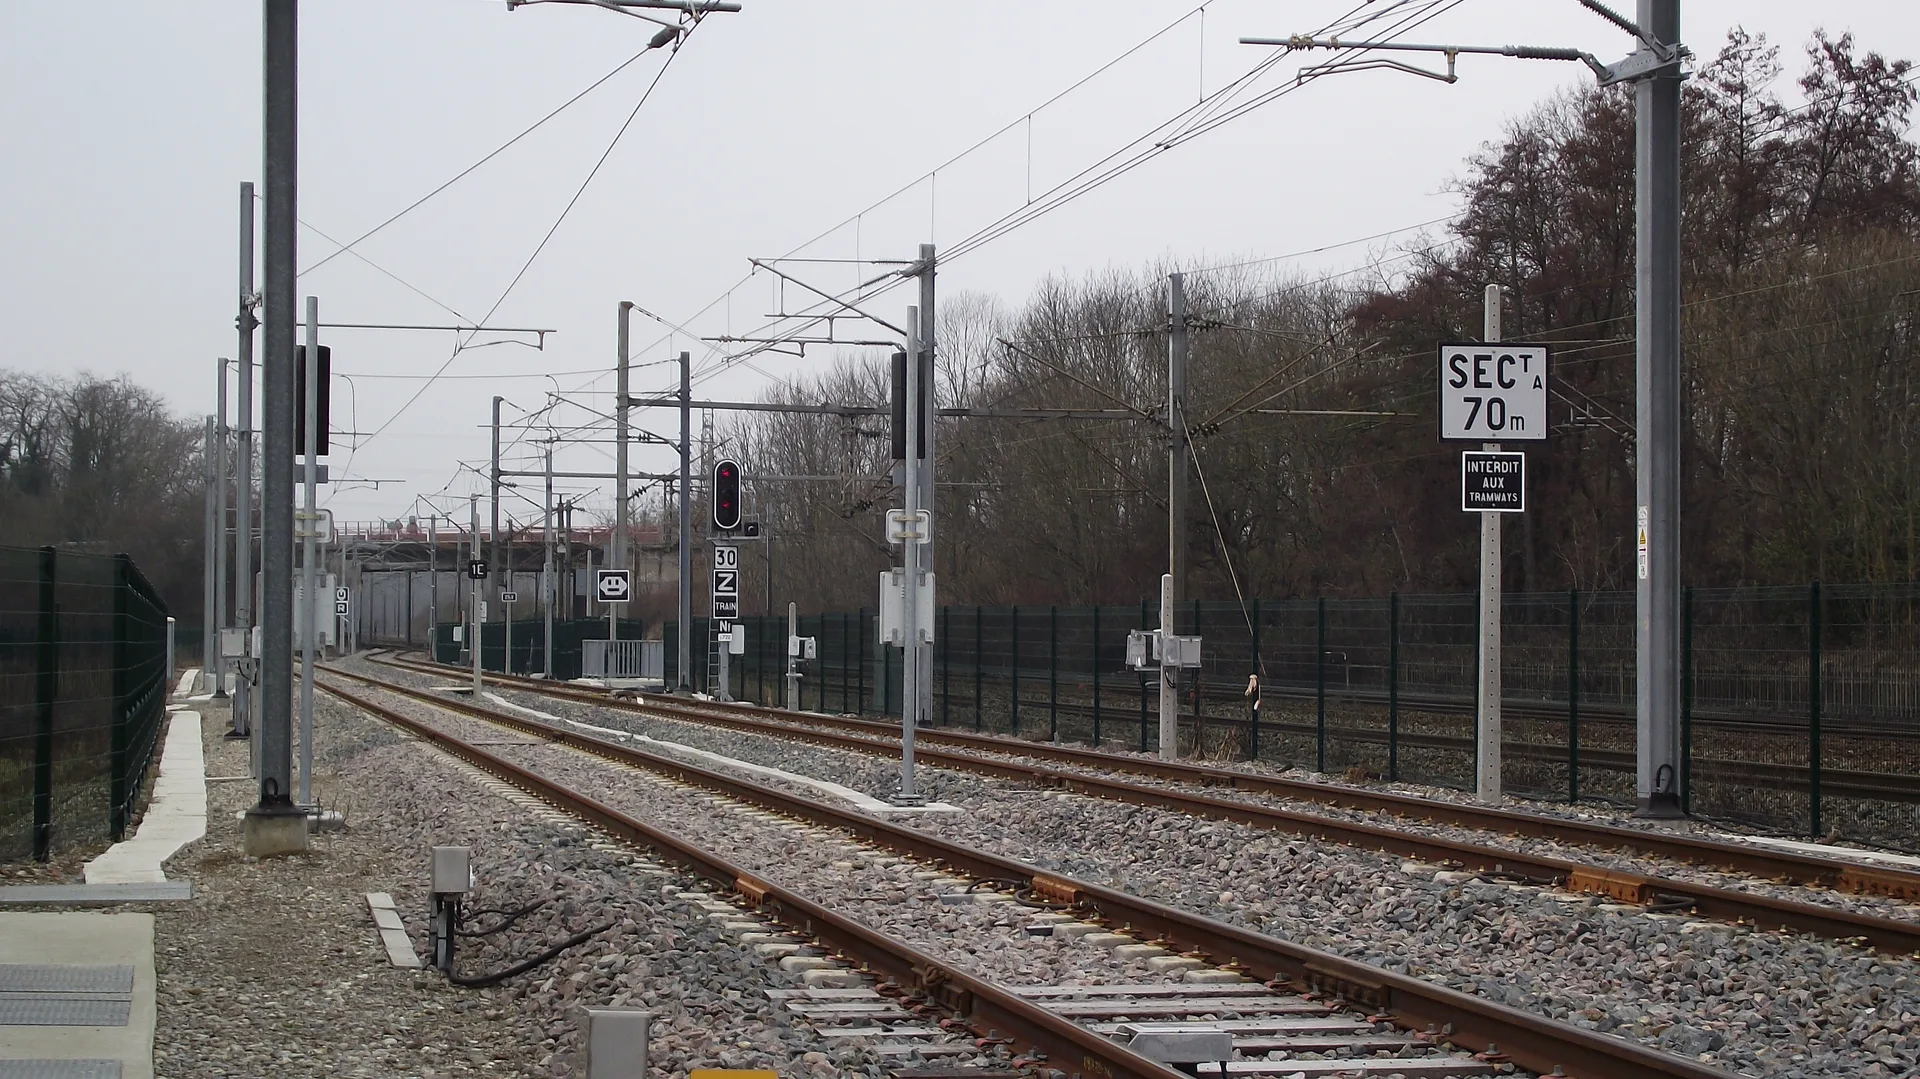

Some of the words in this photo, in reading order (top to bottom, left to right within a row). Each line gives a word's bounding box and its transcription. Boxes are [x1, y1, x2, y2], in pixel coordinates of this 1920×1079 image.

[1467, 461, 1519, 473] INTERDIT
[1482, 477, 1505, 489] AUX
[1469, 491, 1518, 503] TRAMWAYS
[717, 550, 735, 565] 30
[718, 574, 733, 590] Z
[338, 604, 345, 612] R
[715, 602, 736, 610] TRAIN
